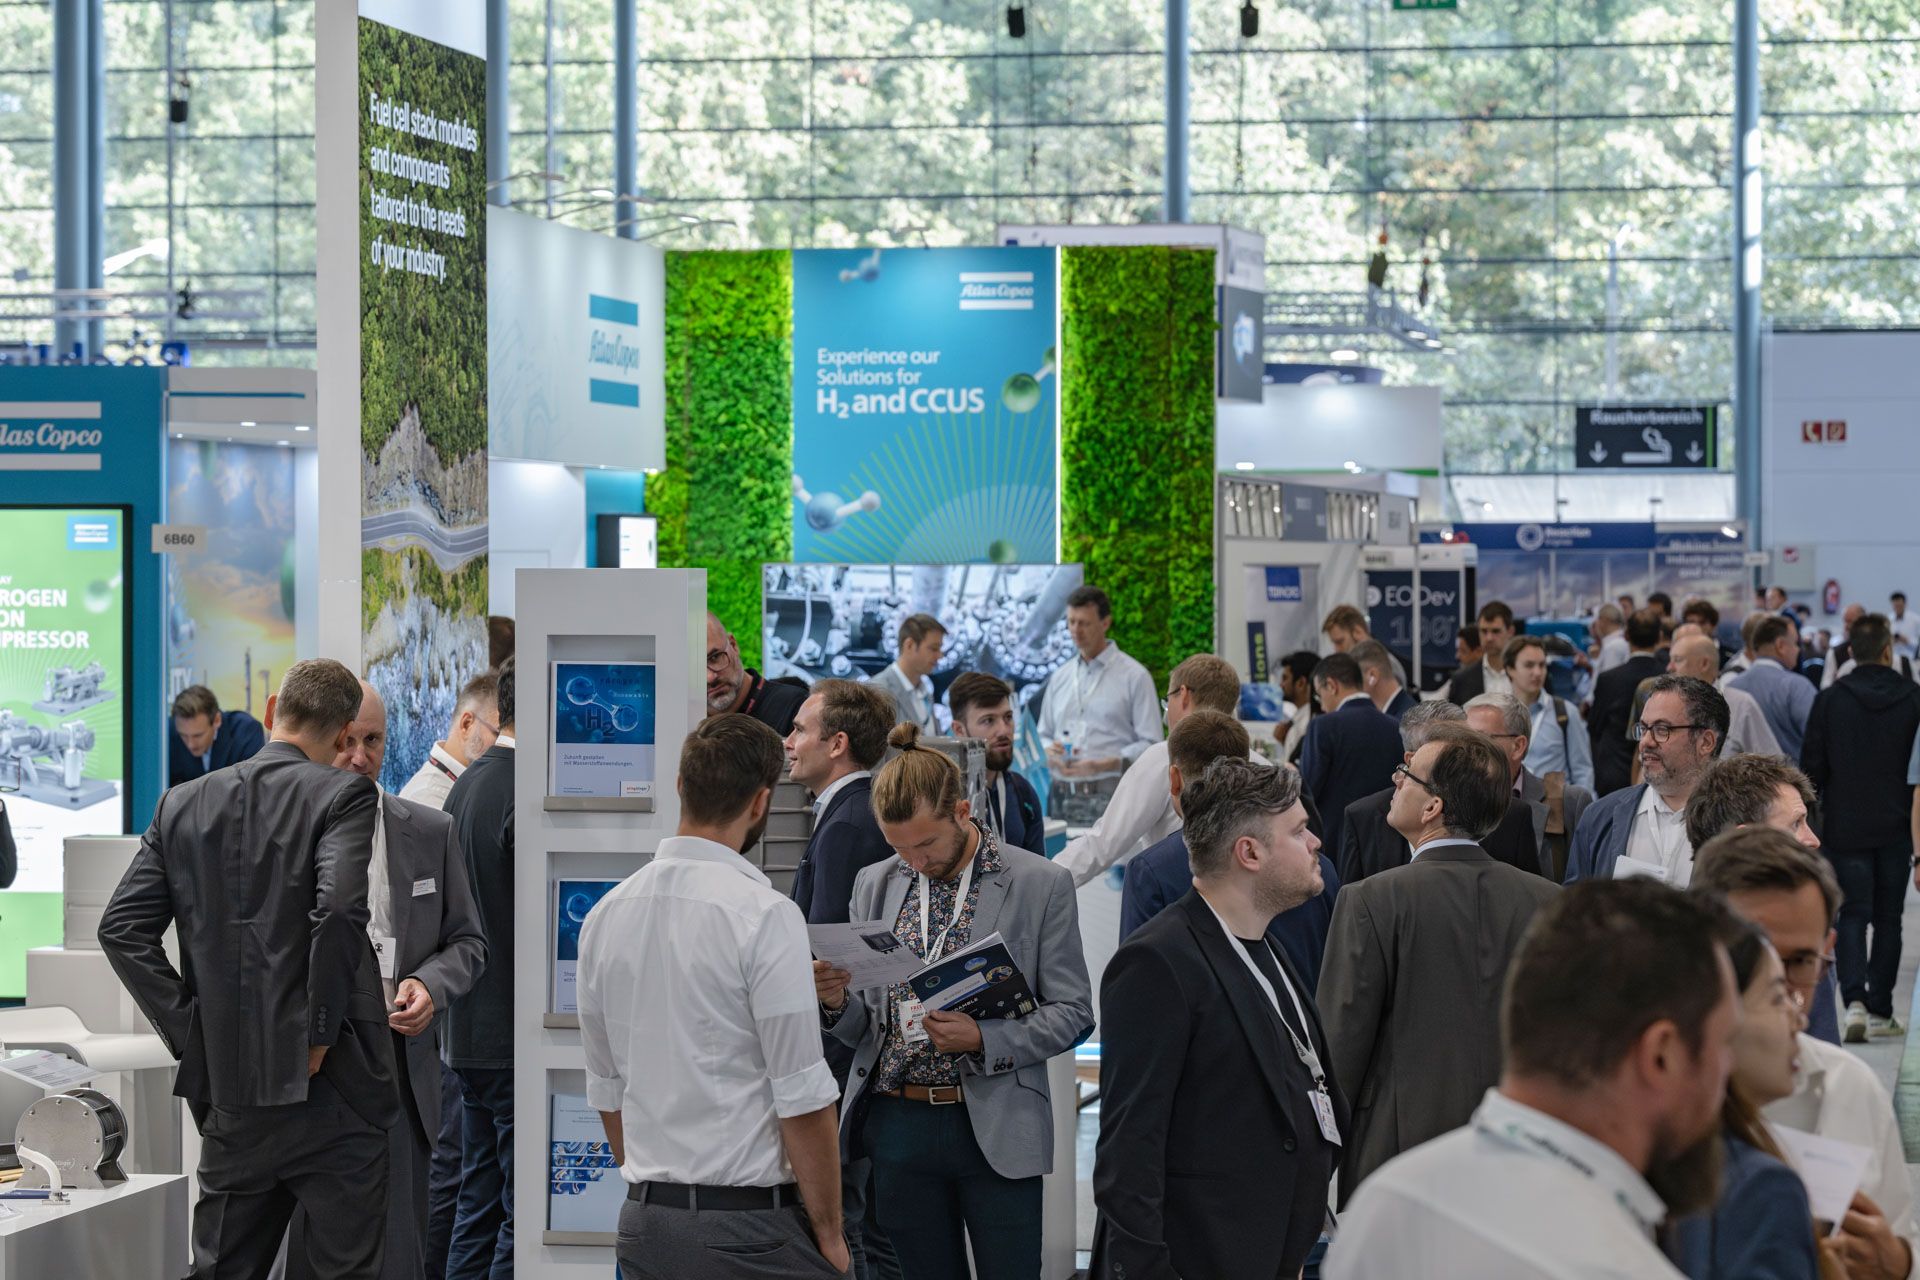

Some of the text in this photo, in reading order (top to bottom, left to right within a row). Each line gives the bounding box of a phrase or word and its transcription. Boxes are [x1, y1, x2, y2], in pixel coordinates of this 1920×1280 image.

[370, 93, 477, 152] Fuel cell stack modules
[371, 144, 450, 189] and components
[371, 188, 465, 237] tailored to the needs
[371, 235, 447, 284] of your industry.
[817, 348, 940, 367] Experience our
[816, 368, 921, 385] Solutions for
[852, 387, 906, 414] and
[909, 388, 985, 414] CCUS
[36, 423, 102, 451] Copco
[164, 533, 196, 545] 6B60
[1384, 585, 1457, 607] EODev
[0, 630, 90, 649] PRESSOR
